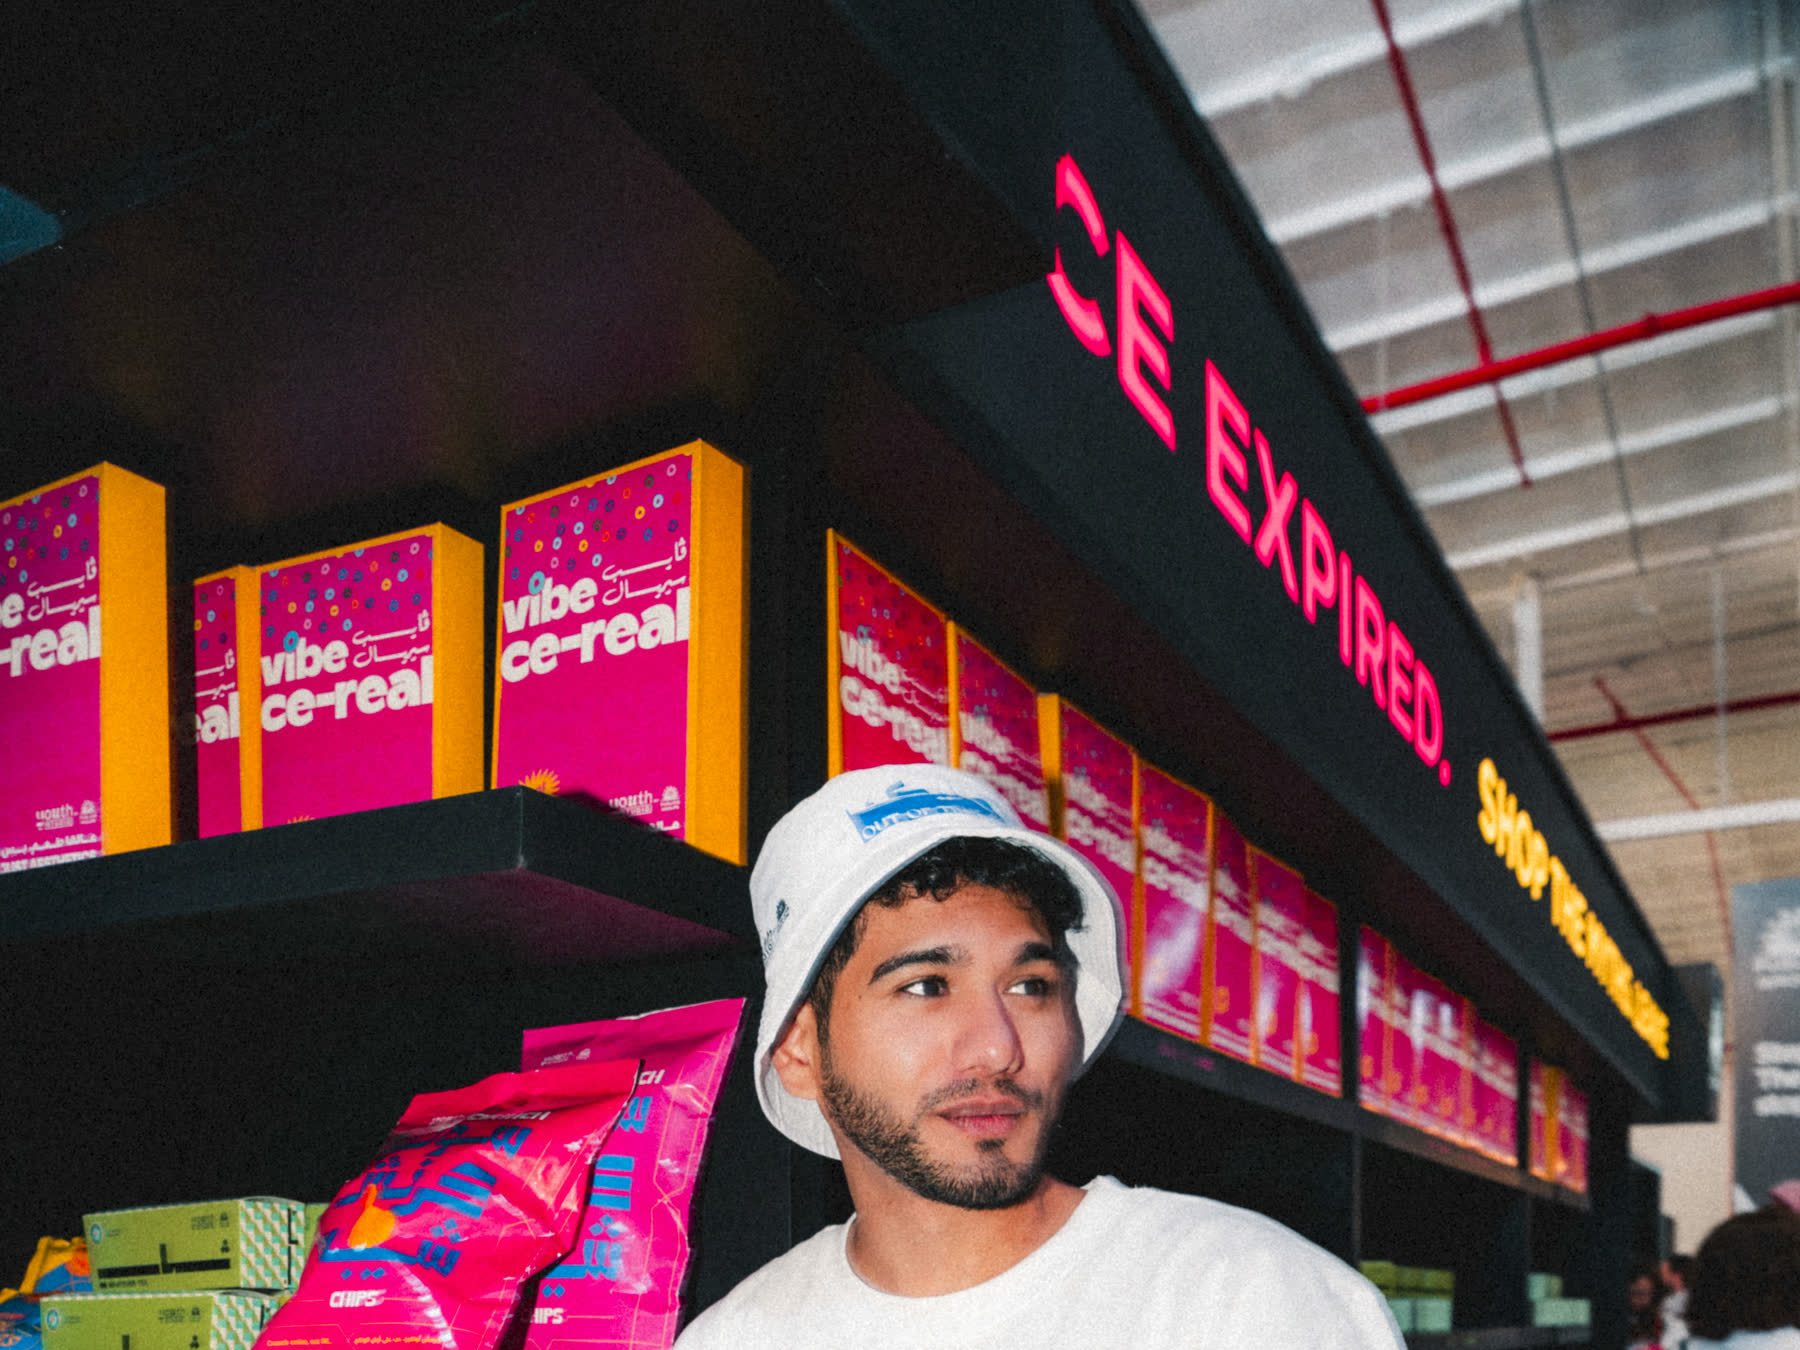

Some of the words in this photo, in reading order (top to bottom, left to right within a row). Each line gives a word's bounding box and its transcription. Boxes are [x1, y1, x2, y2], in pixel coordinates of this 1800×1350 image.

[503, 571, 599, 634] vibe
[1205, 357, 1452, 788] EXPIRED.
[261, 630, 350, 687] vibe
[500, 586, 691, 683] ce-real
[840, 624, 901, 695] vibe
[261, 655, 435, 733] ce-real
[841, 675, 950, 765] ce-real
[862, 812, 900, 839] OUT
[1477, 757, 1550, 901] SHOP
[329, 1290, 384, 1308] CHIPS
